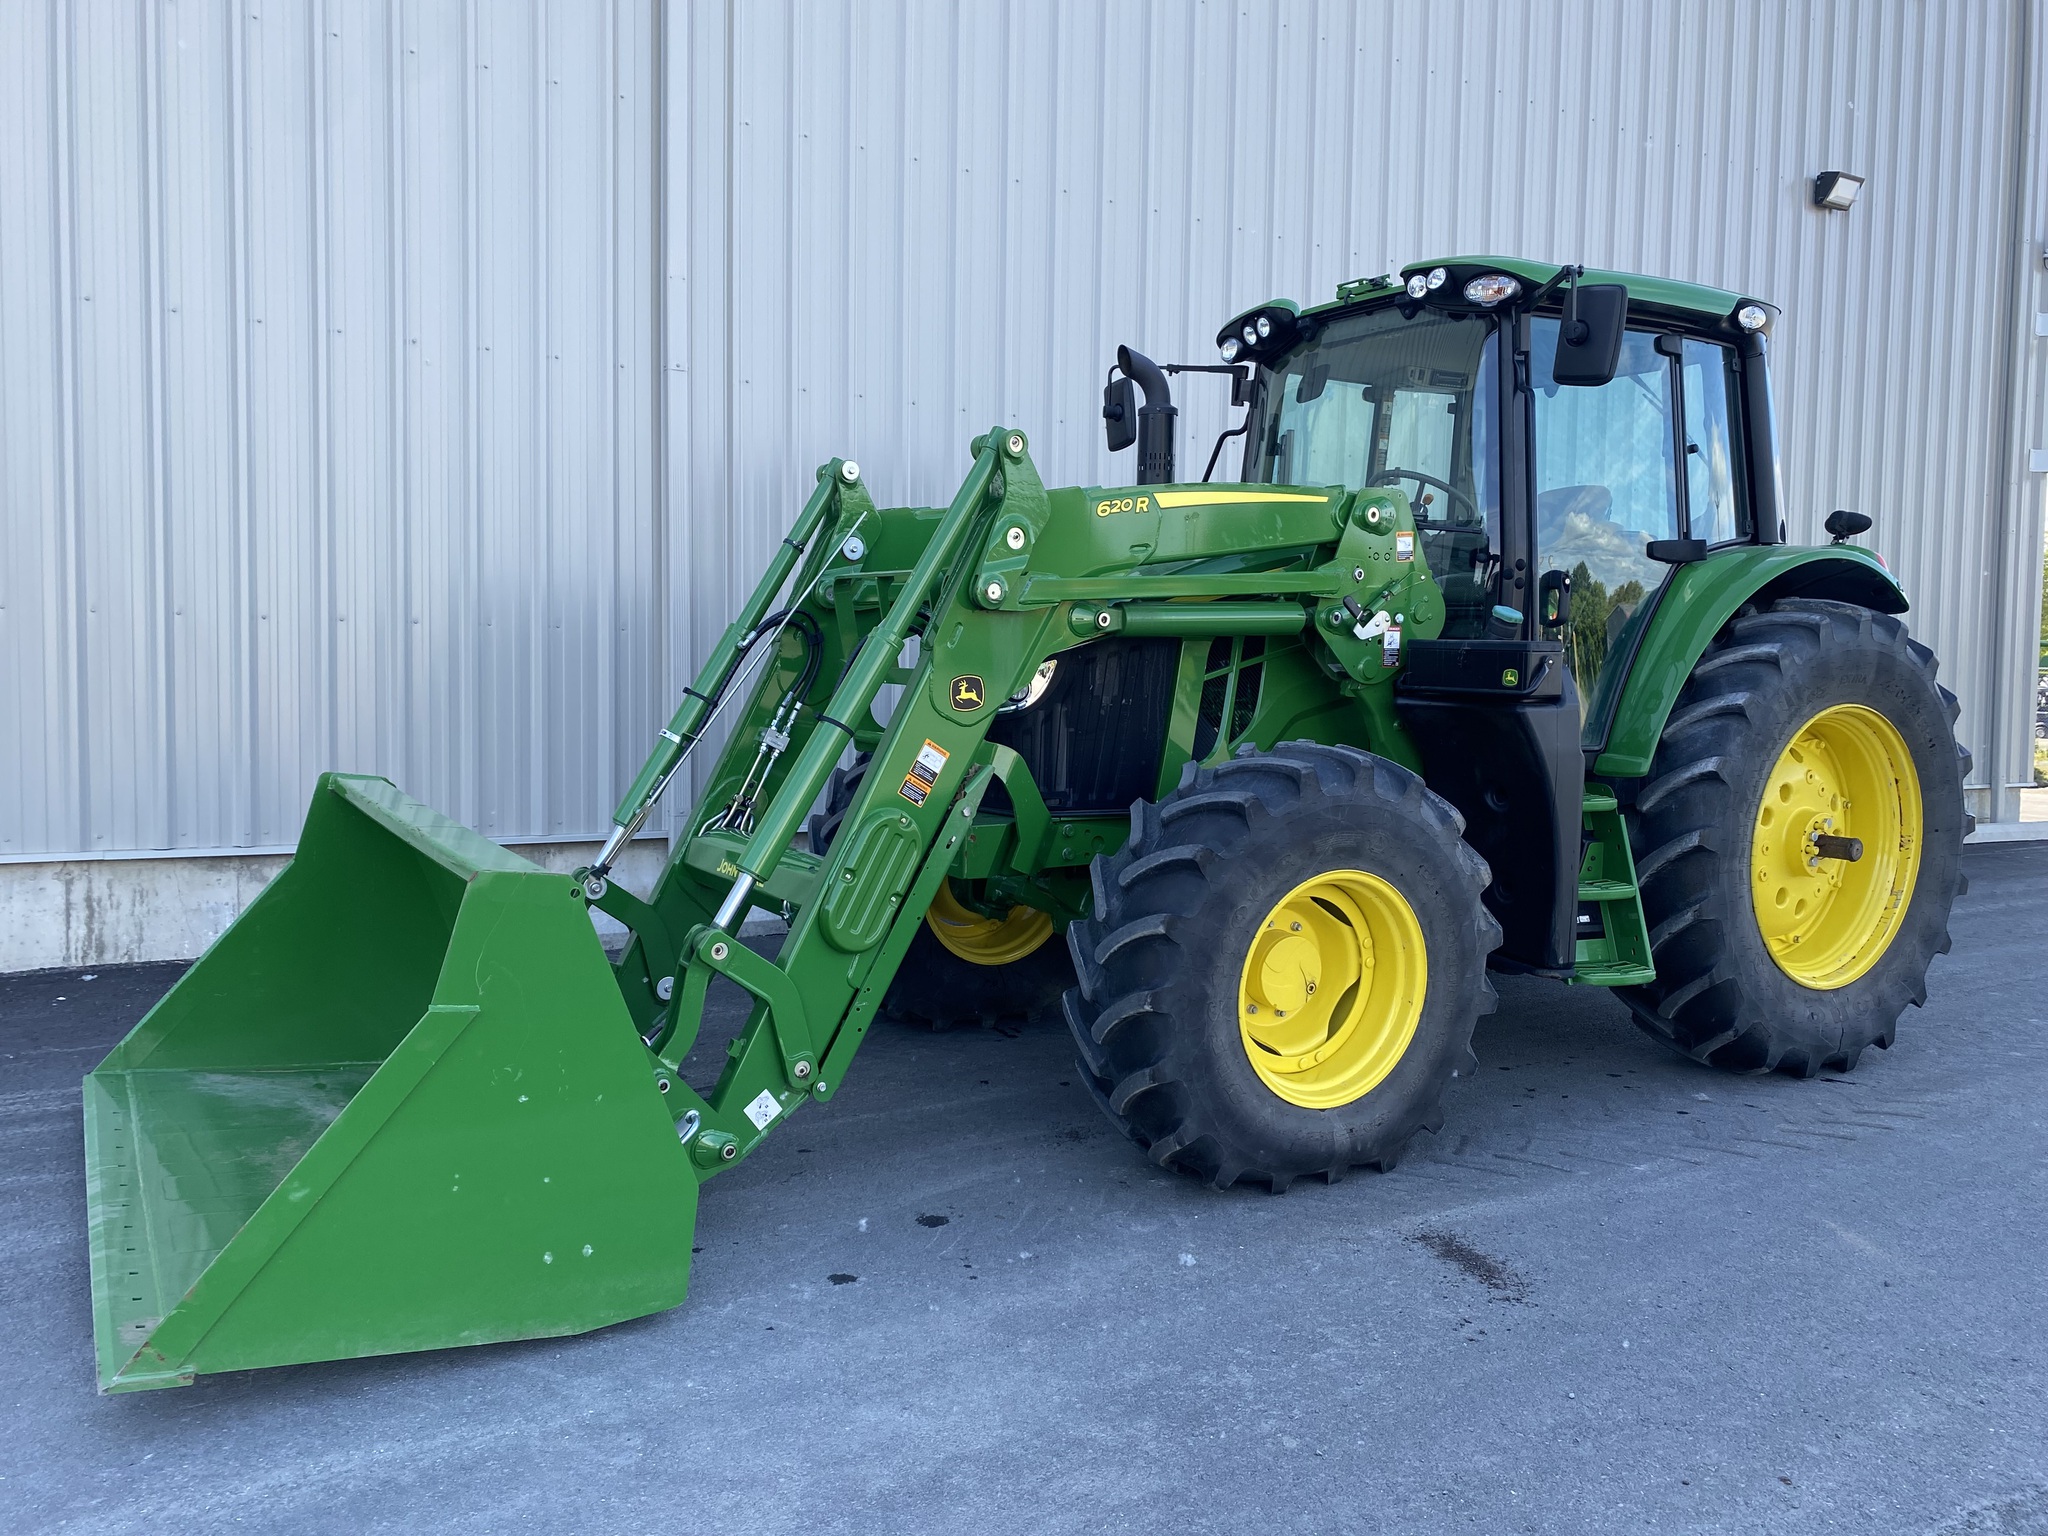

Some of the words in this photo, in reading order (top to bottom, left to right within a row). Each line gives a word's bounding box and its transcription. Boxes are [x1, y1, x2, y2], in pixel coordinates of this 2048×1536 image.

[1096, 498, 1134, 517] 620
[1135, 496, 1150, 514] R
[716, 858, 738, 878] JOHN
